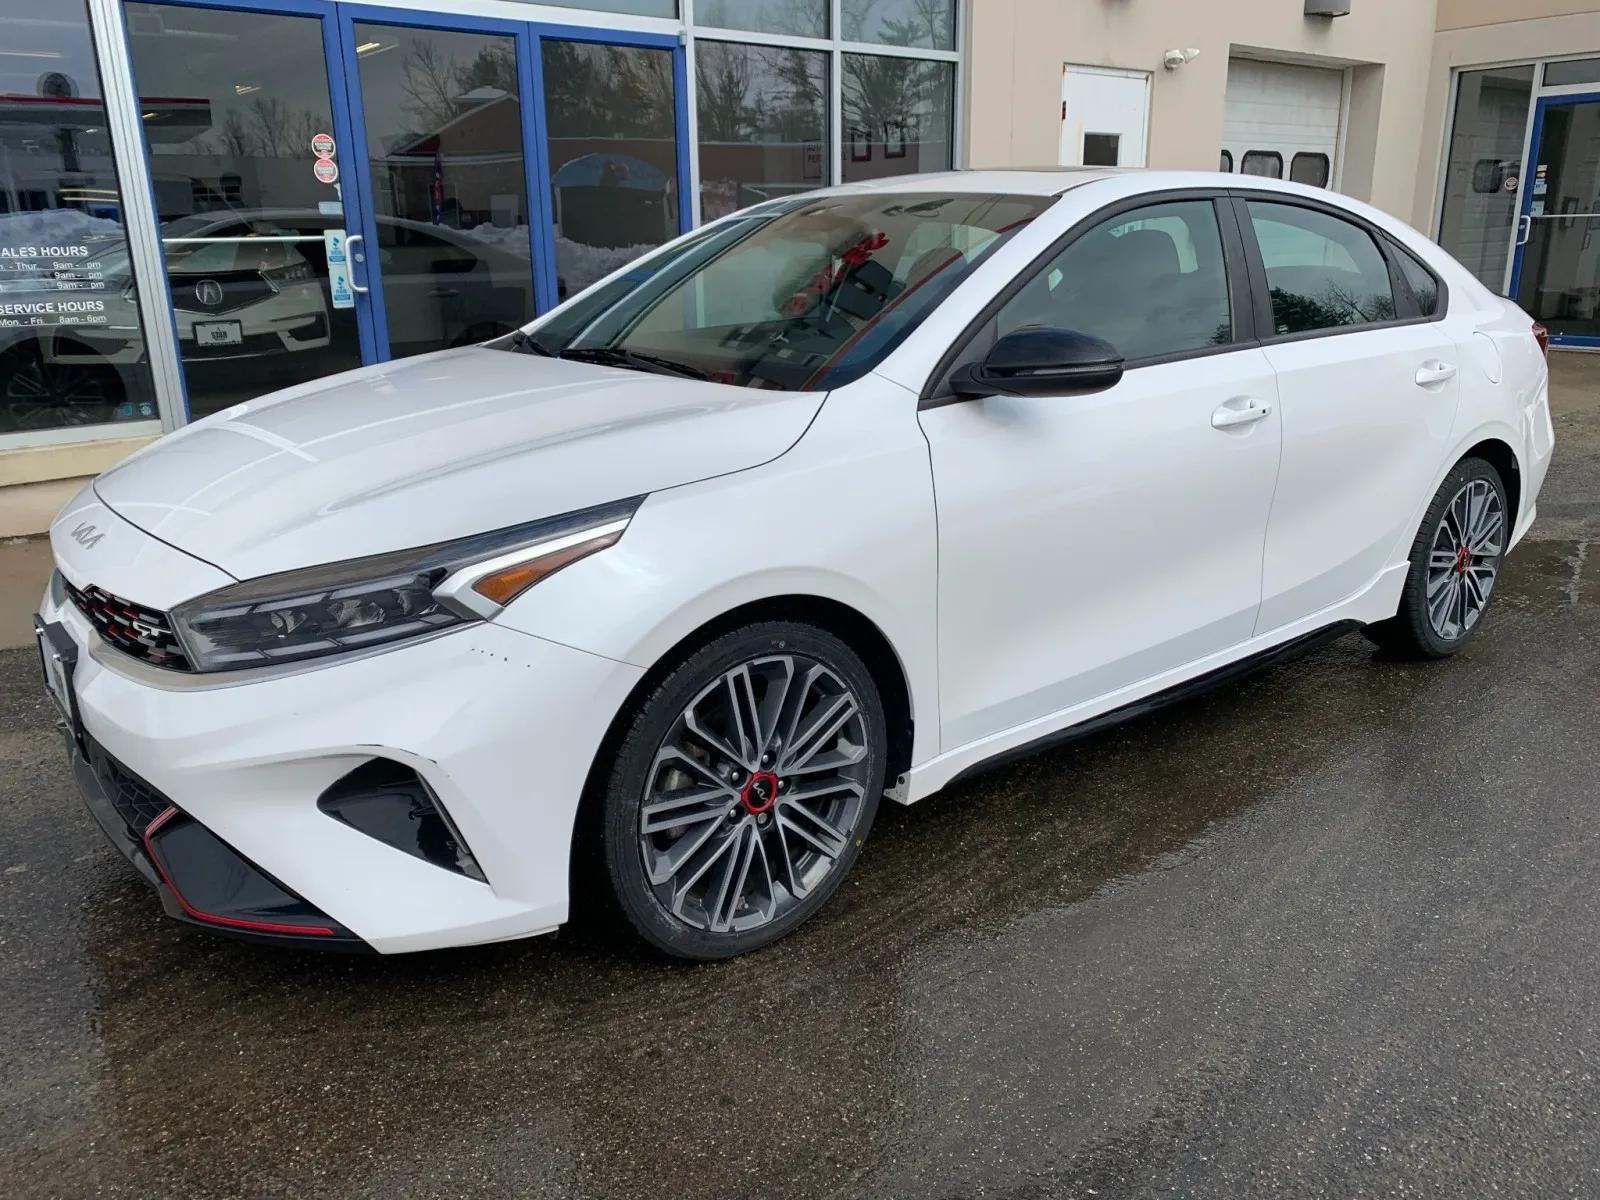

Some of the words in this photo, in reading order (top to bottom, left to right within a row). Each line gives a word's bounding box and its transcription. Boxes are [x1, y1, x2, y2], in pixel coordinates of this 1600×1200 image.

[41, 246, 88, 256] HOURS
[0, 303, 54, 313] SERVICE
[58, 301, 104, 311] HOURS
[87, 315, 106, 323] 6pm
[133, 620, 172, 637] GT
